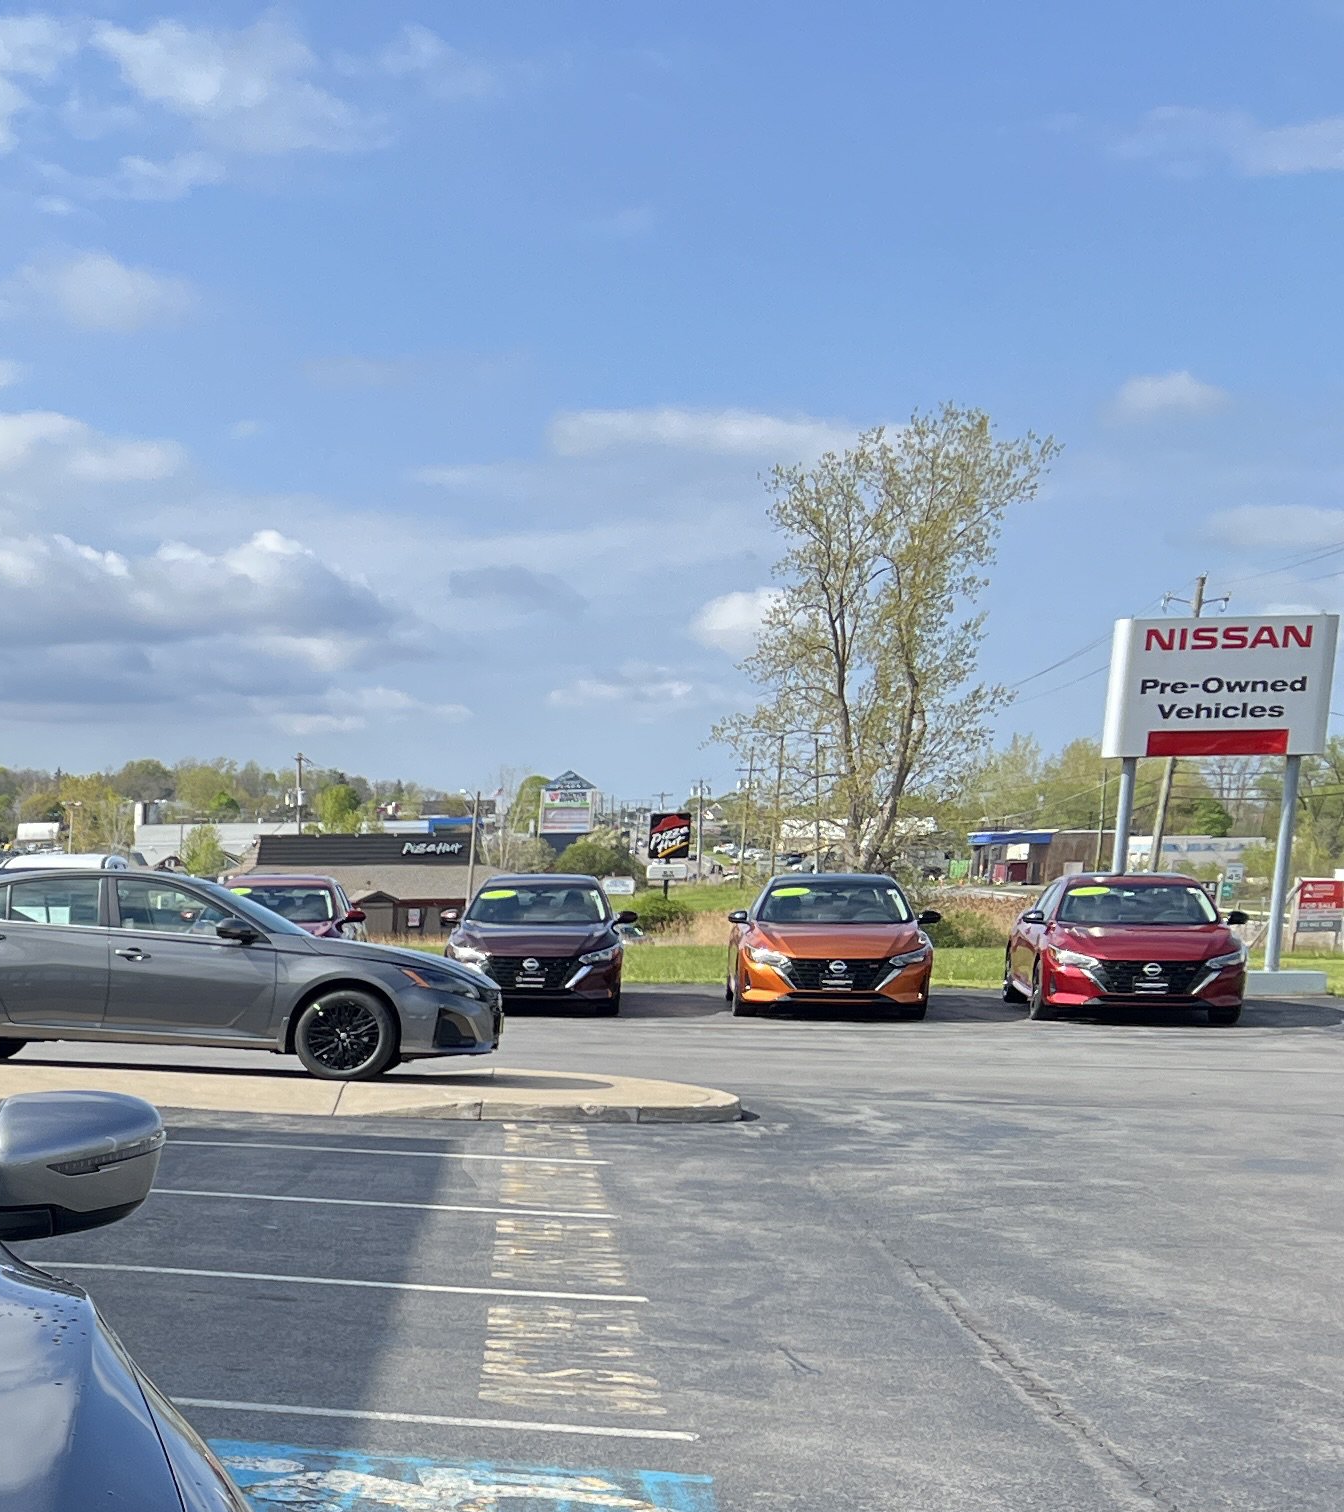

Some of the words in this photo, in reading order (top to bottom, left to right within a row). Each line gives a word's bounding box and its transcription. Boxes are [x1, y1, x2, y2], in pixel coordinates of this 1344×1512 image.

[1145, 625, 1313, 651] NISSAN
[1140, 676, 1308, 695] Pre-Owned
[1158, 702, 1285, 720] Vehicles
[650, 826, 690, 850] Pizza
[657, 835, 686, 854] Hut
